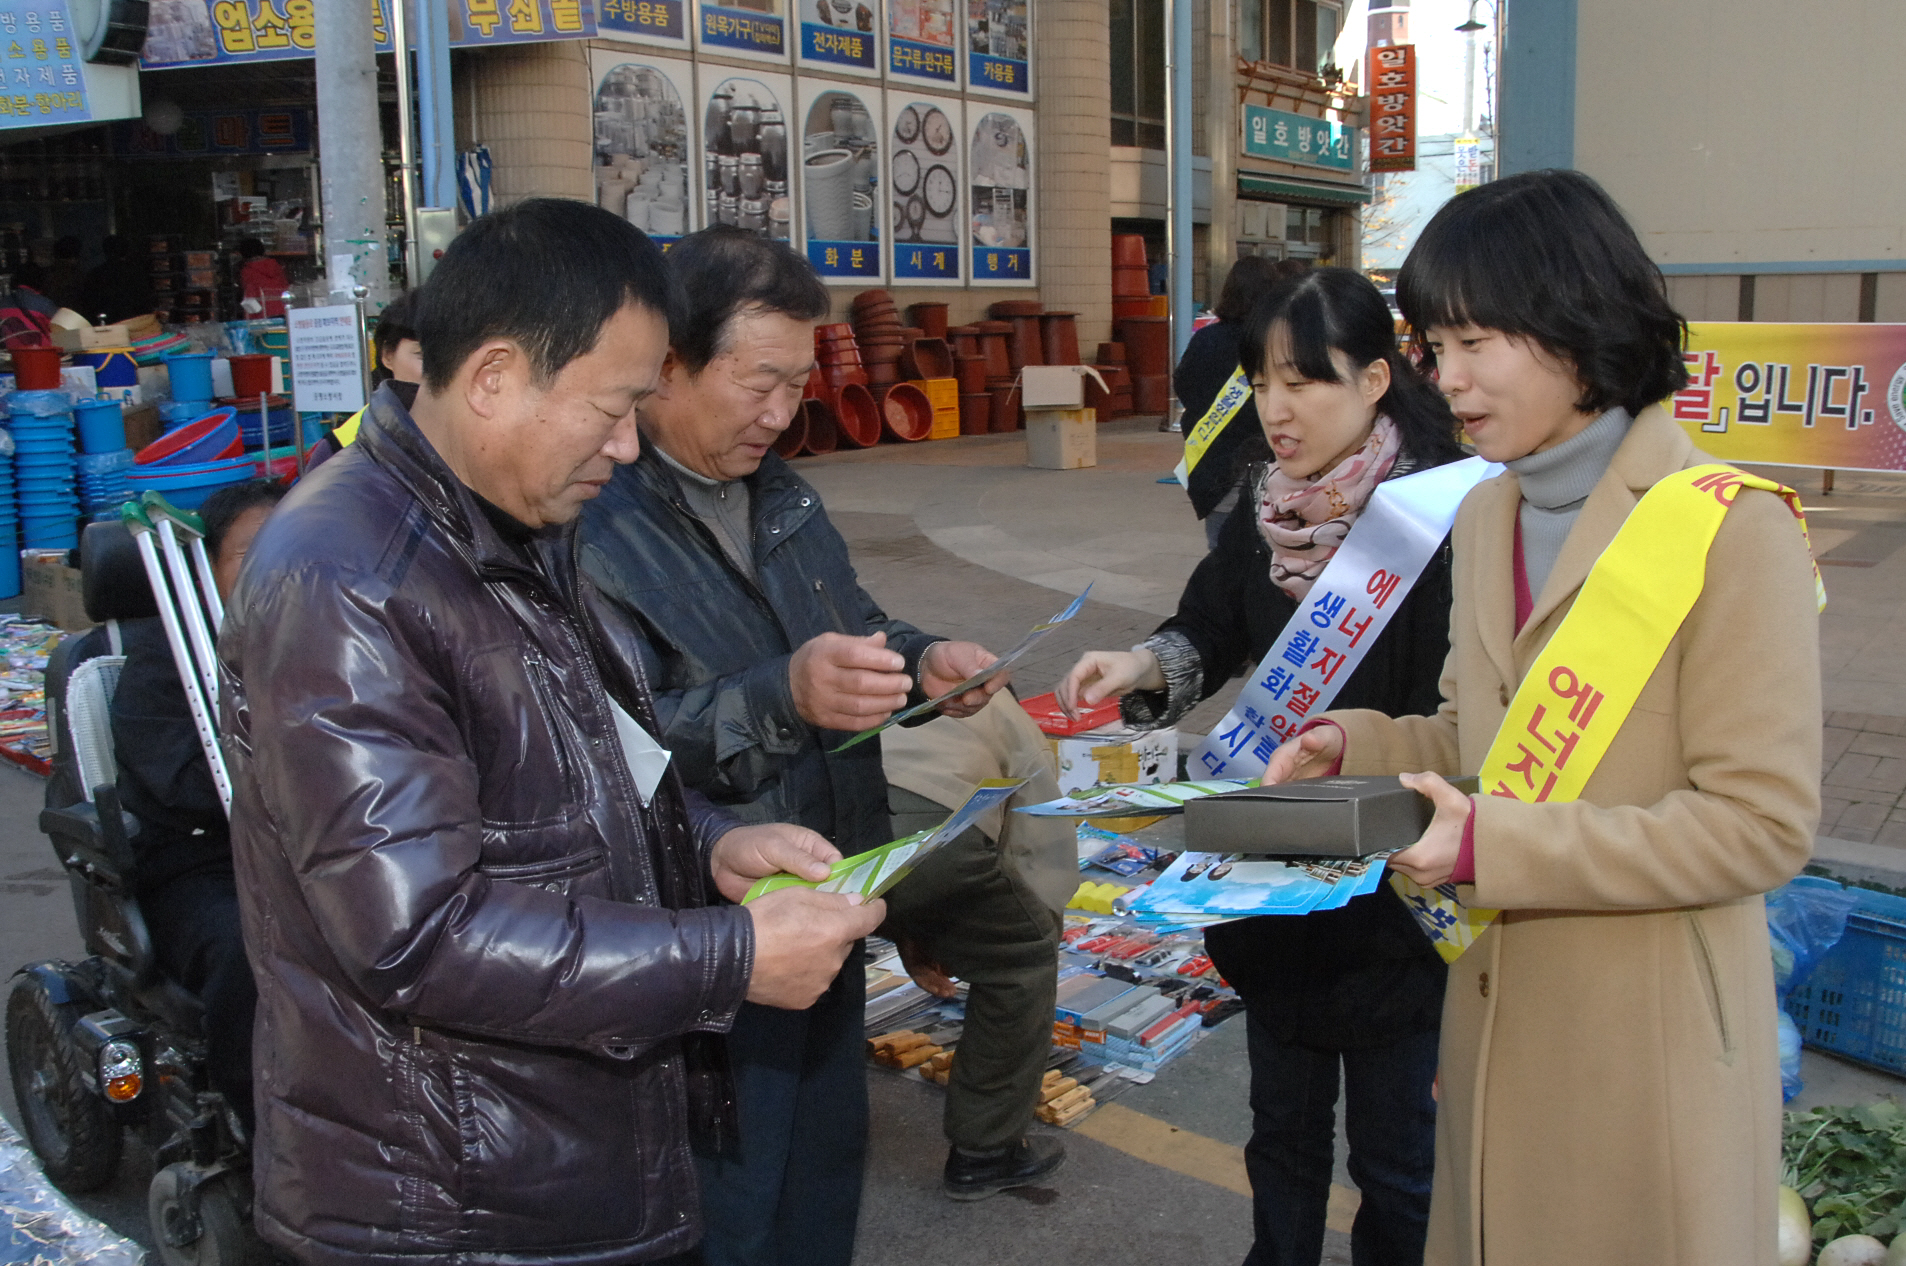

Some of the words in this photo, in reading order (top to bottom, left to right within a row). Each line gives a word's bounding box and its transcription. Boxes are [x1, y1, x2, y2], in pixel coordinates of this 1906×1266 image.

[705, 14, 752, 40] 원목가구
[813, 32, 864, 58] 전자제품
[984, 61, 1015, 83] 카용품
[1377, 48, 1409, 155] 일호방앗간
[1252, 116, 1349, 160] 일호방앗간
